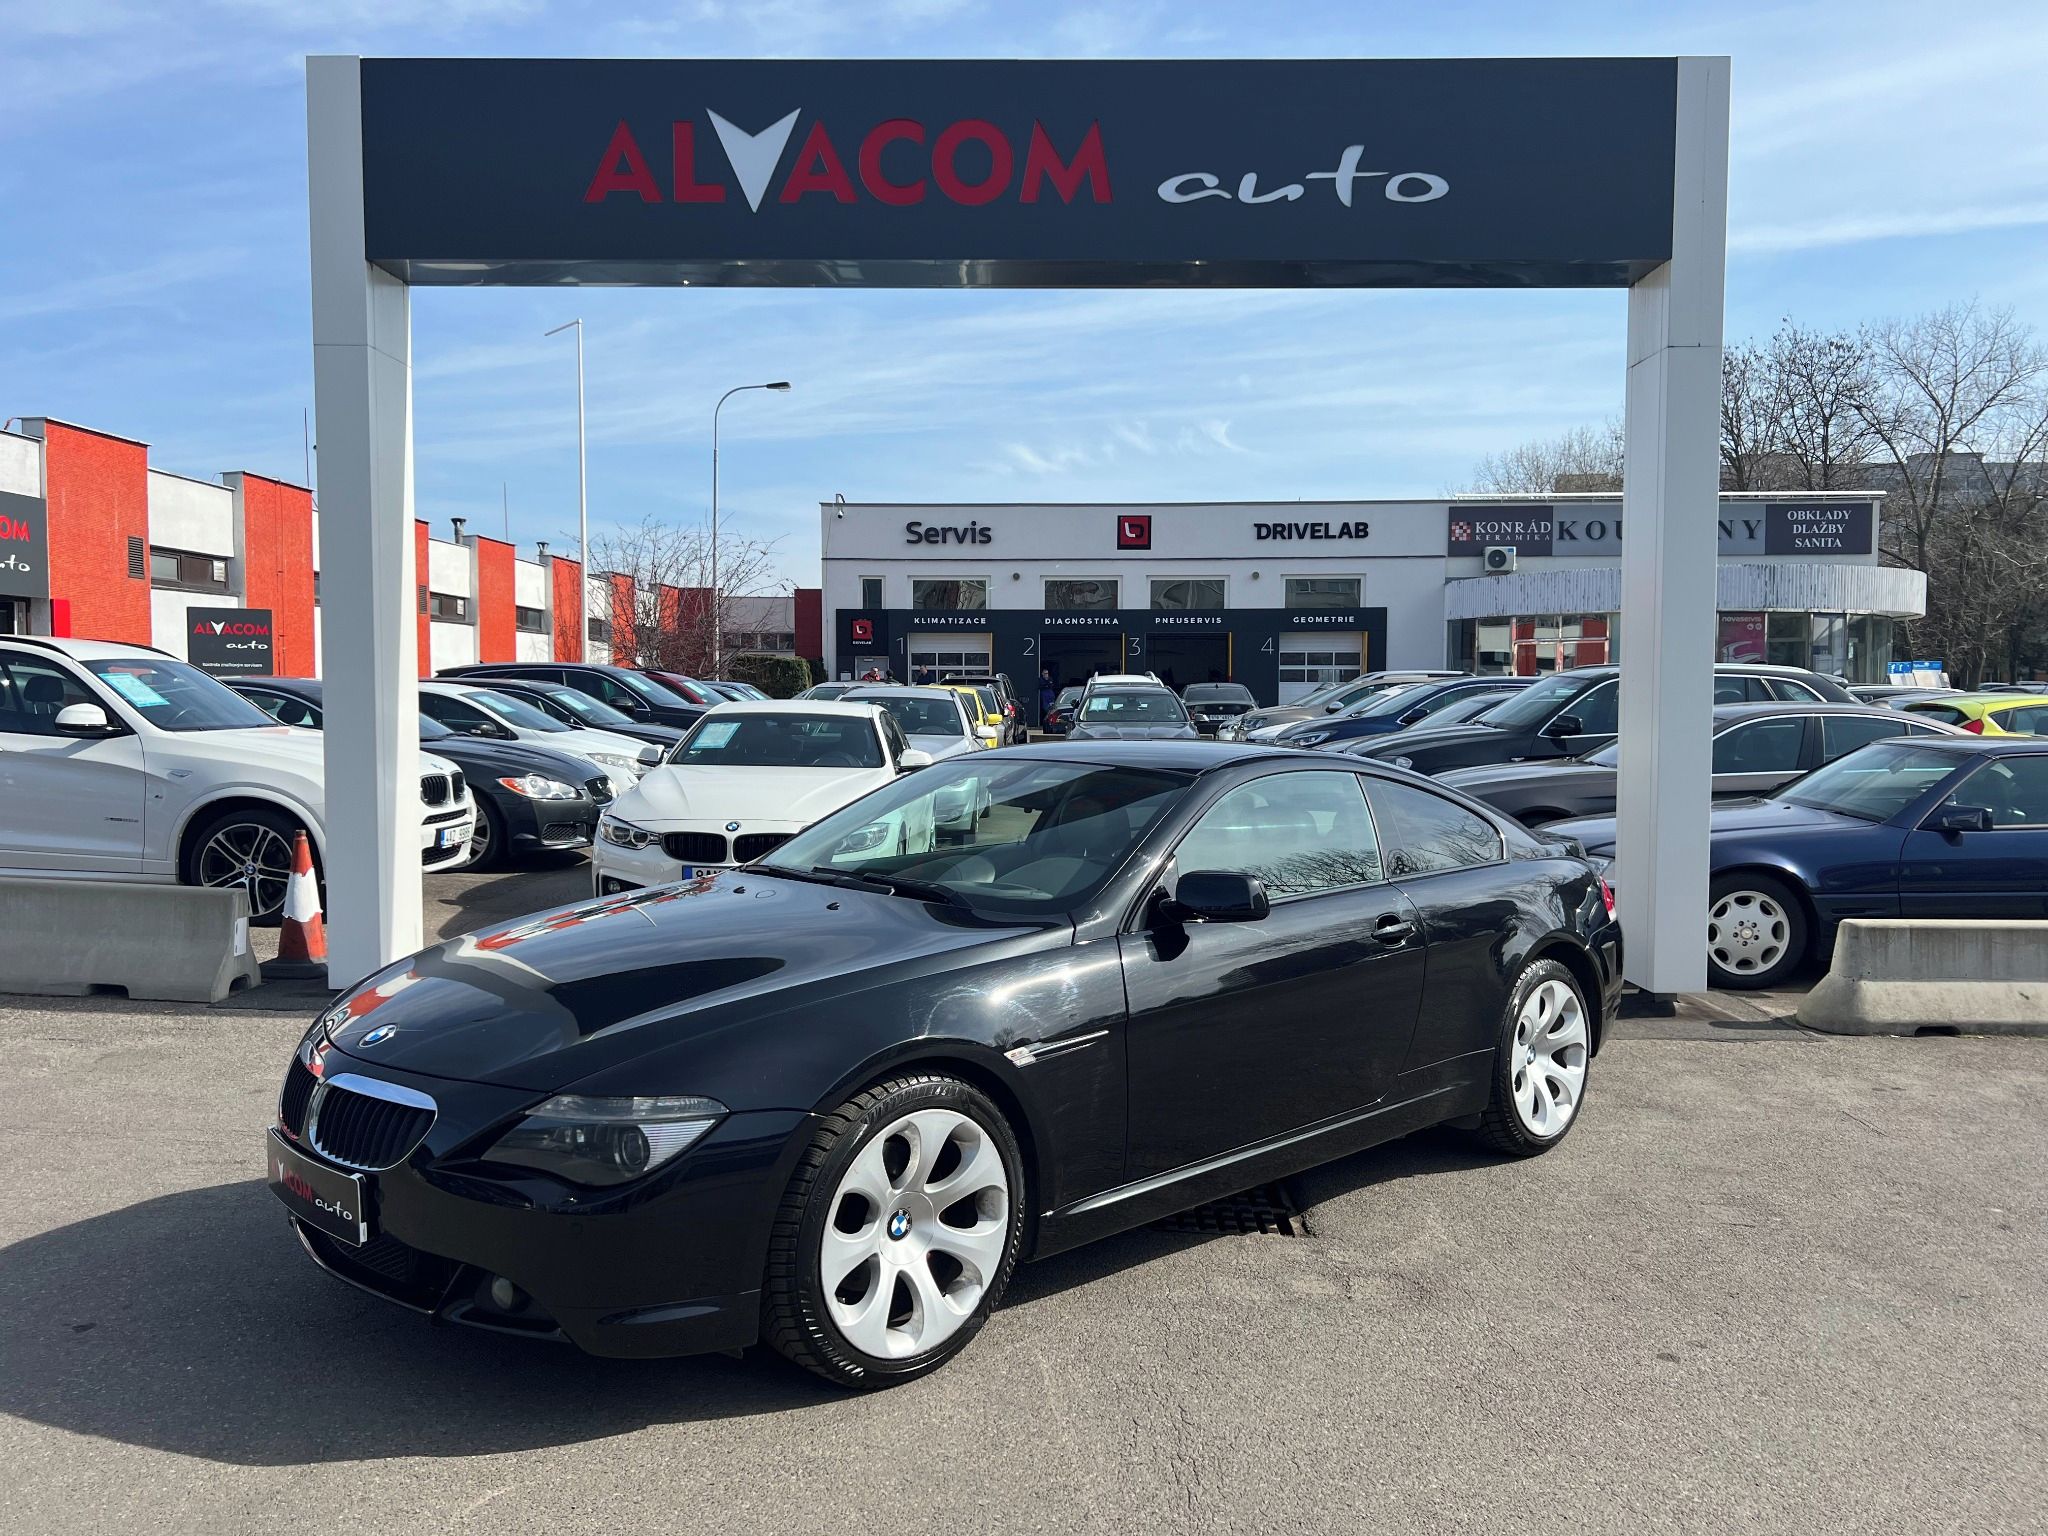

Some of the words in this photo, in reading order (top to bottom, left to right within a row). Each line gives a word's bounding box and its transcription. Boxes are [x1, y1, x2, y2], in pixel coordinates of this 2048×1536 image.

[583, 107, 1114, 214] ALVACOM
[1157, 144, 1450, 208] auto
[1787, 510, 1852, 521] OBKLADY
[906, 520, 992, 544] Servis
[1253, 522, 1369, 540] DRIVELAB
[1475, 519, 1551, 534] KONRÁD
[1793, 522, 1846, 534] DLAŽBY
[1795, 538, 1842, 548] SANITA
[193, 620, 270, 636] ALVACOM
[914, 617, 987, 625] KLIMATIZACE
[1044, 617, 1120, 625] DIAGNOSTIKA
[226, 640, 269, 650] auto
[895, 637, 905, 655] 1
[1023, 637, 1035, 656] 2
[1128, 637, 1141, 656] 3
[1260, 637, 1274, 655] 4
[315, 1198, 353, 1221] auto
